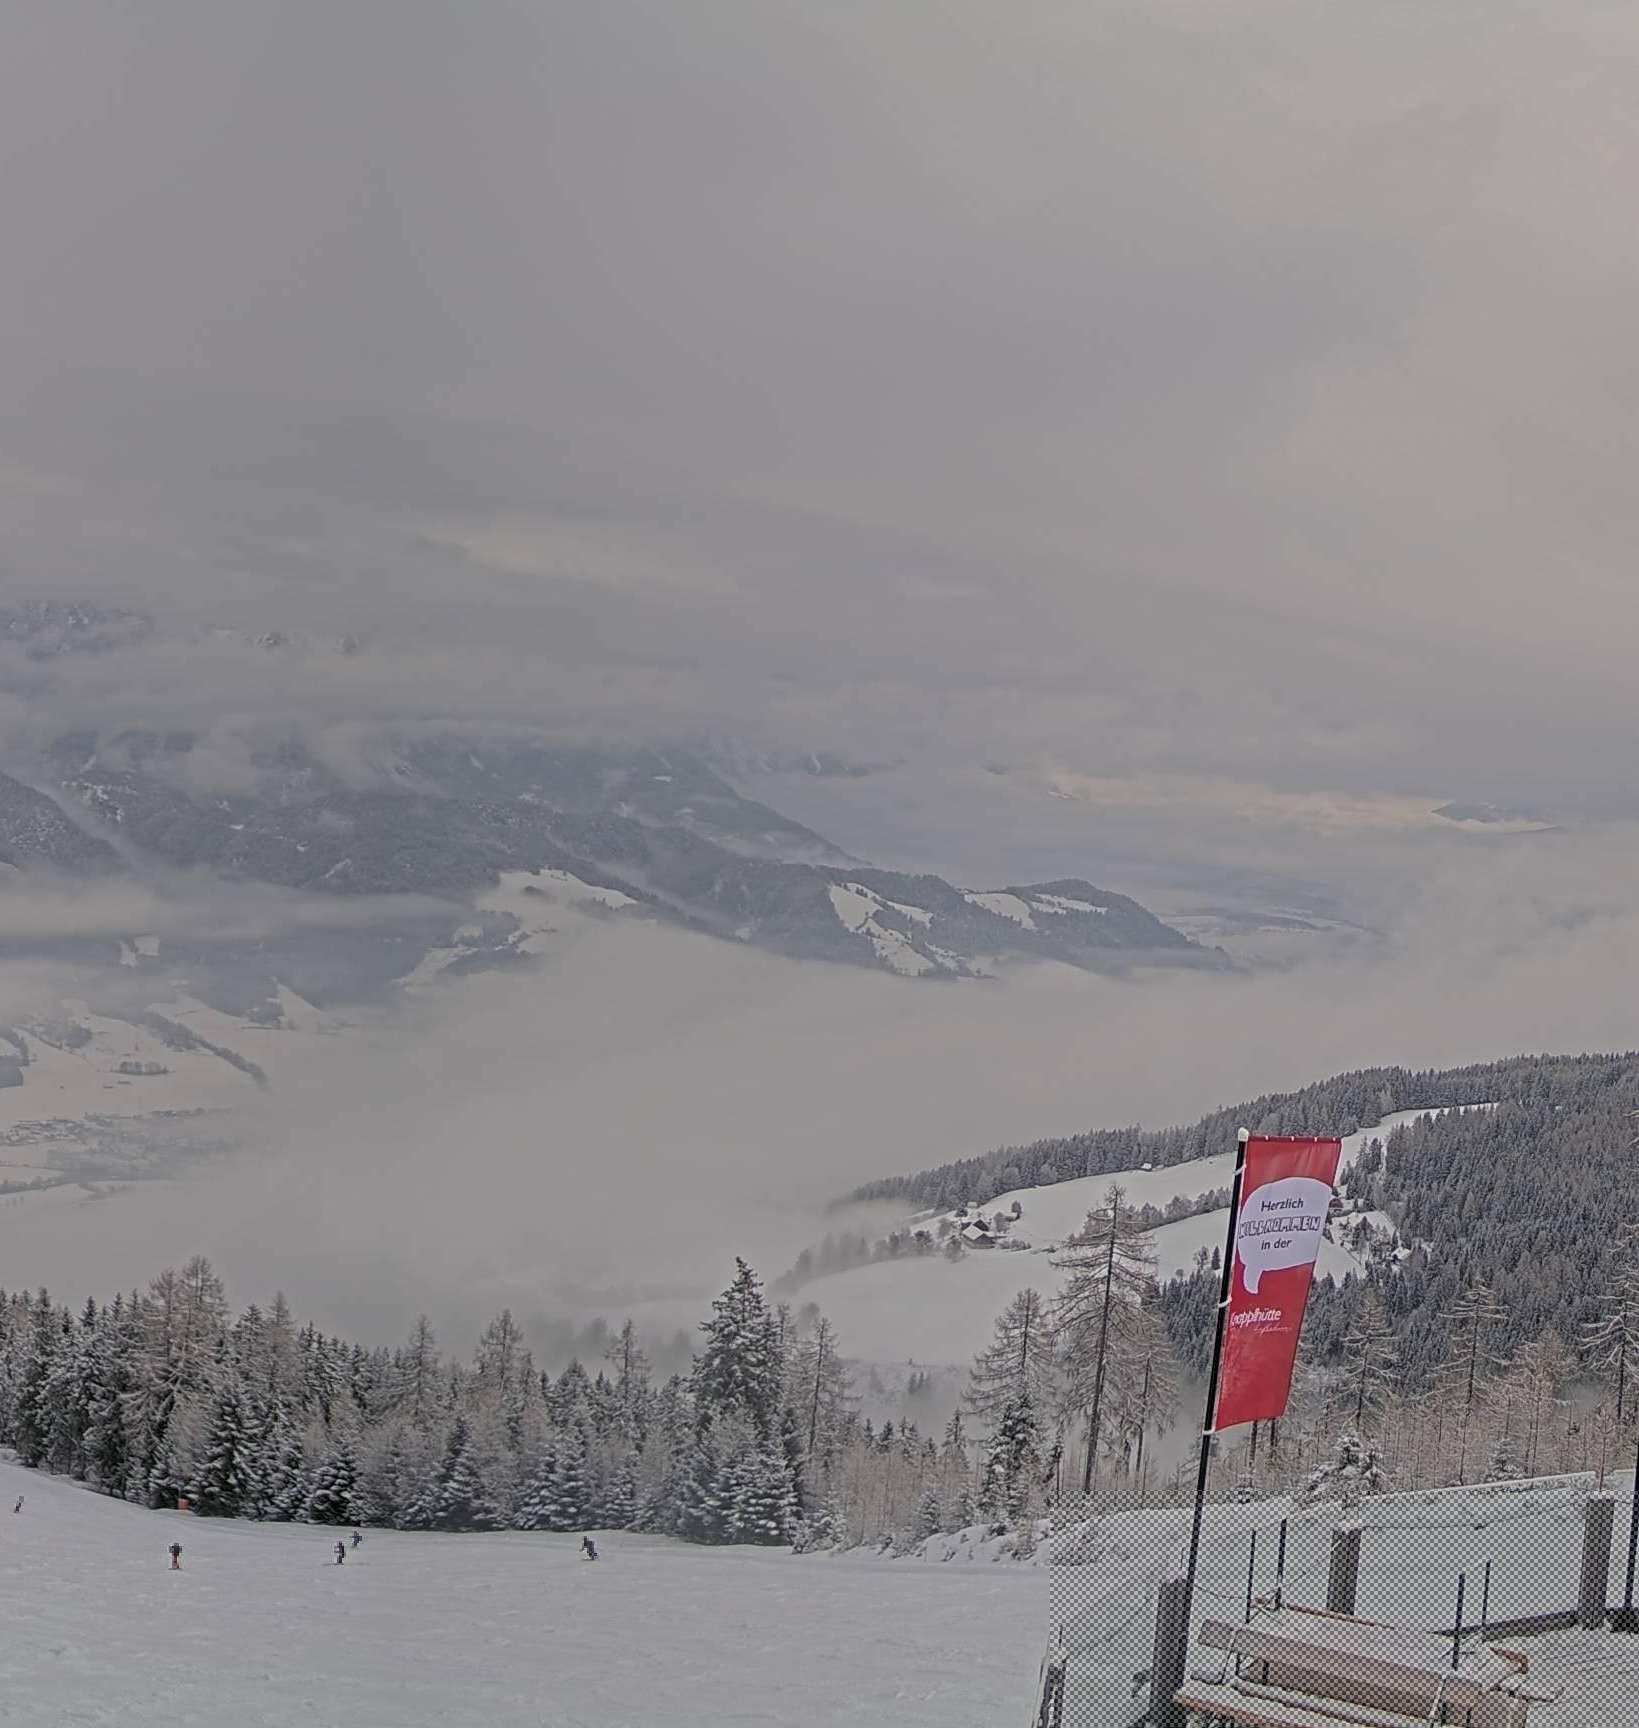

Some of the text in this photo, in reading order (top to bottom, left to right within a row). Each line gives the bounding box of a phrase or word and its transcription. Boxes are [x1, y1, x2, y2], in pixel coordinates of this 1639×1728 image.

[1261, 1198, 1304, 1212] Herzlich
[1261, 1238, 1293, 1250] in der
